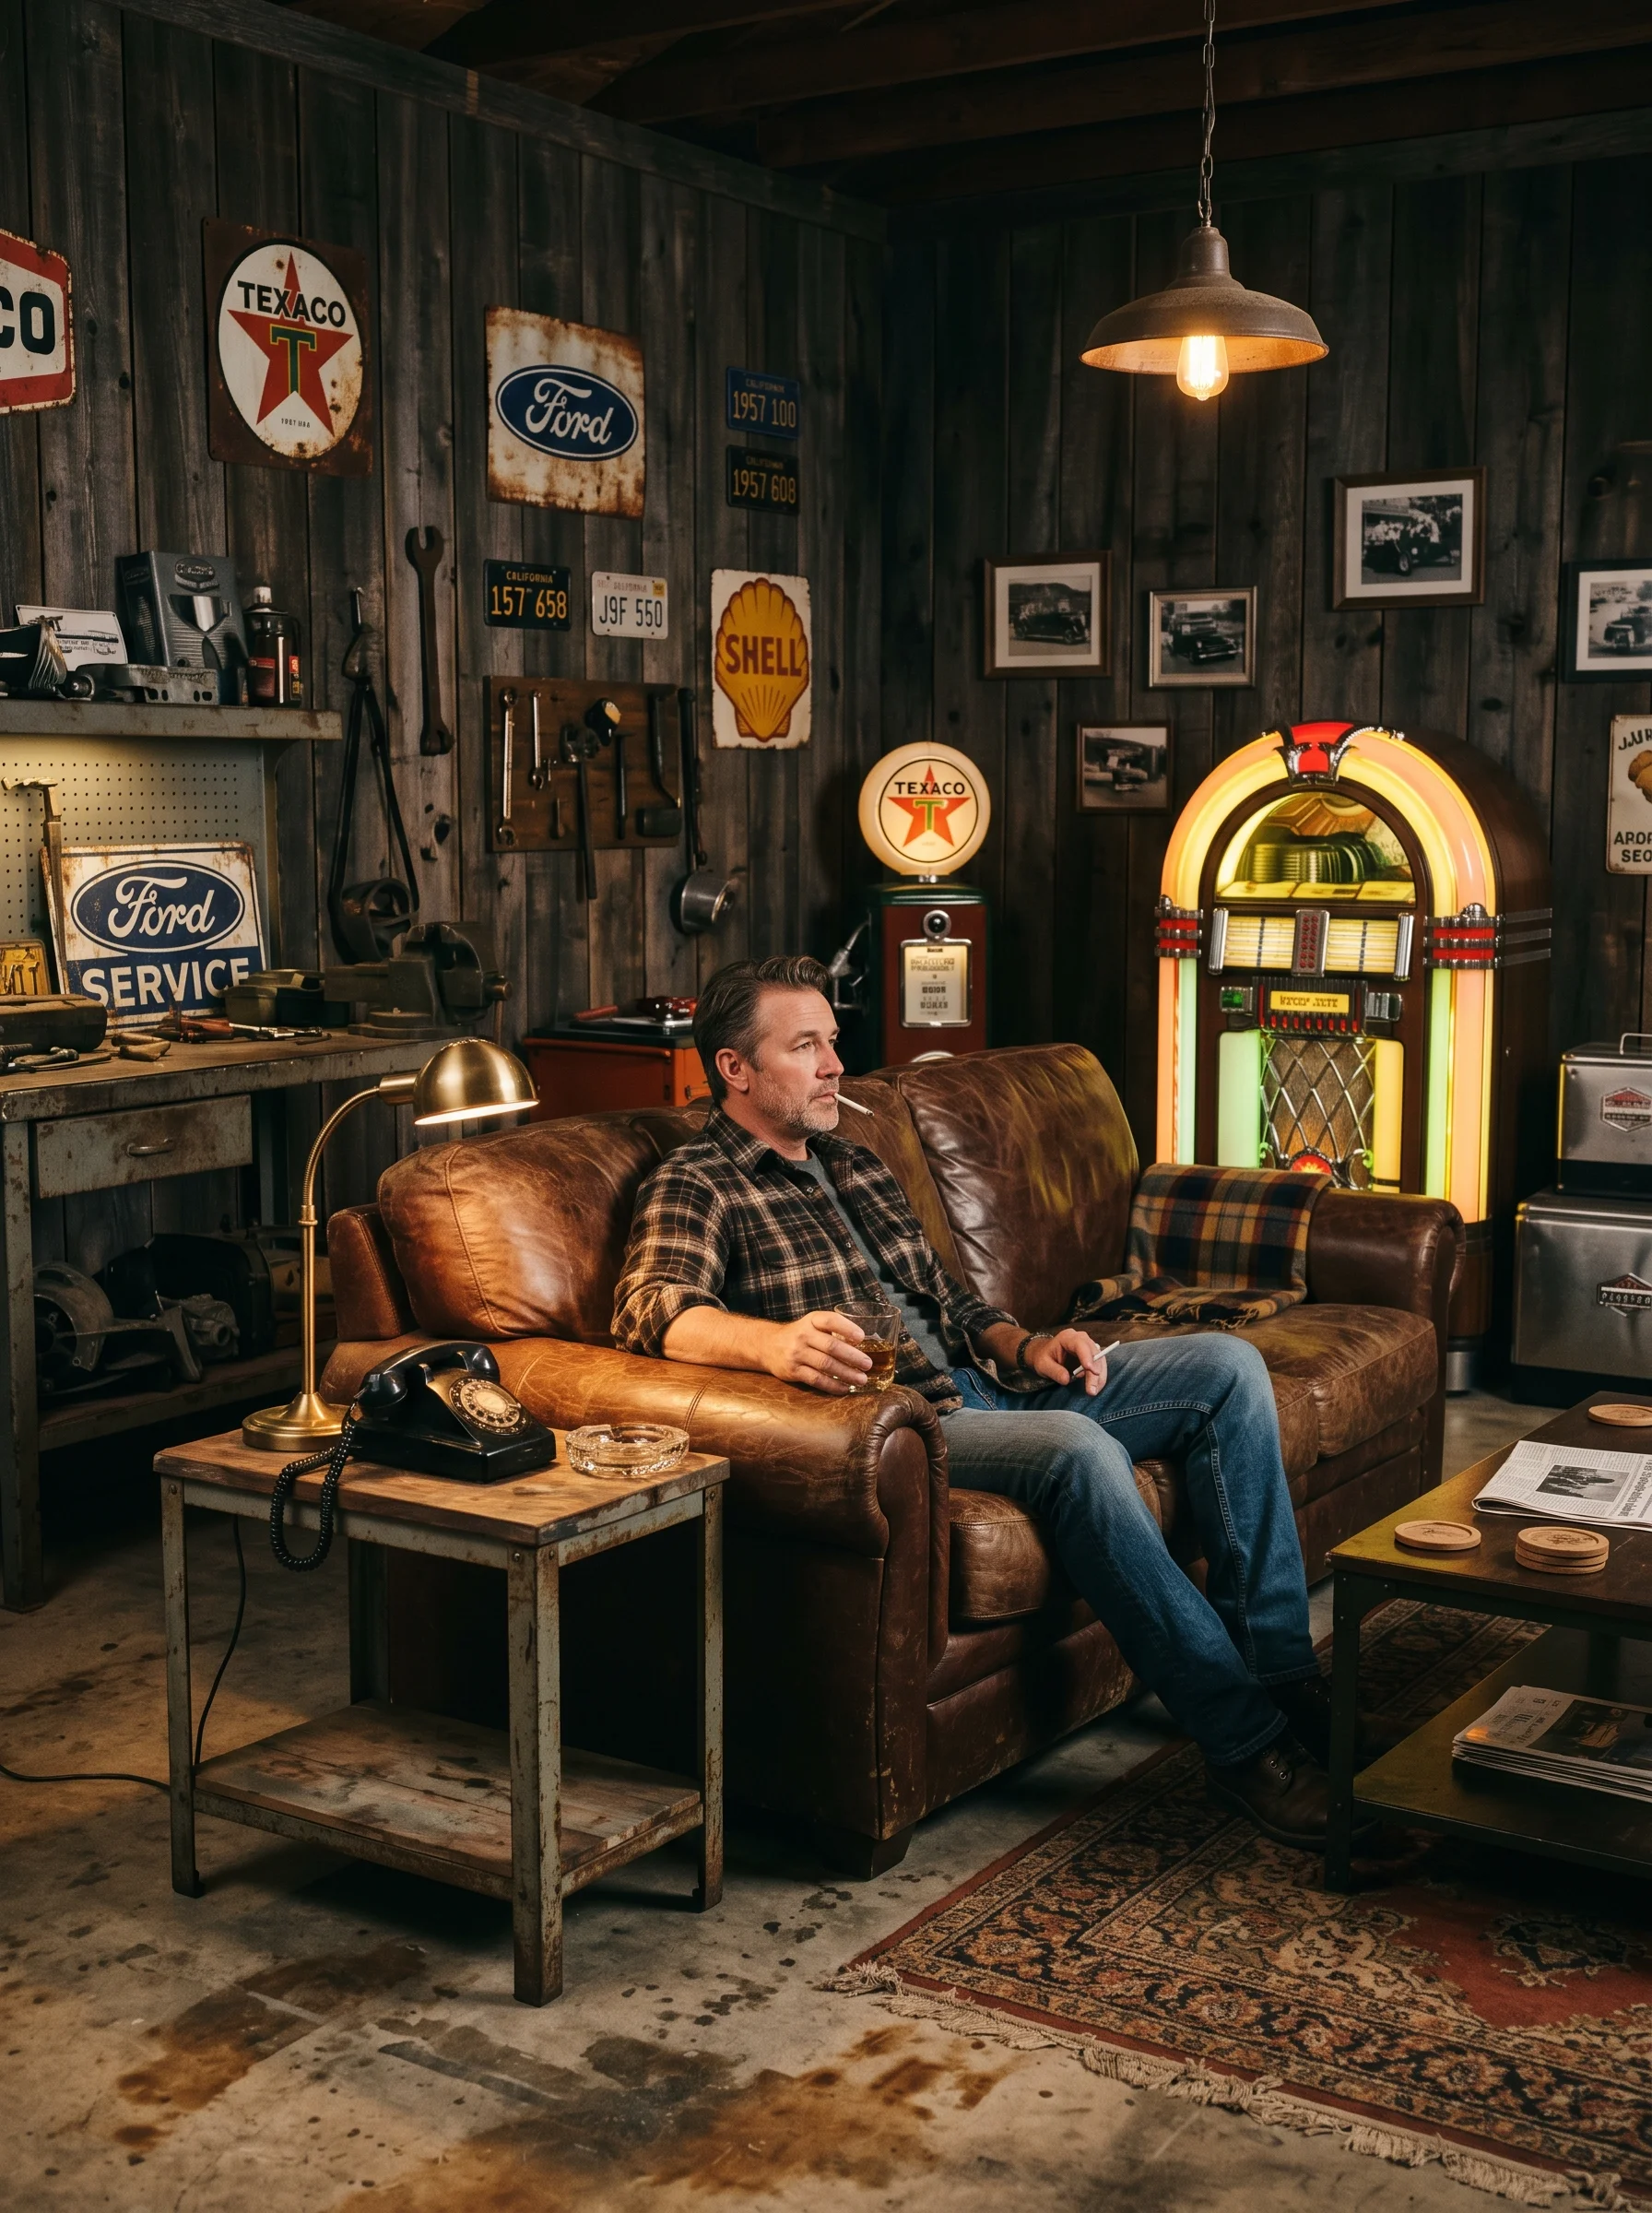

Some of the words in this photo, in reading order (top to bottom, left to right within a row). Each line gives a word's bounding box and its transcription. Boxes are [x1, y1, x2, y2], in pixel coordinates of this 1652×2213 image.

[237, 280, 346, 327] TEXACO
[525, 377, 614, 445] Ford
[733, 390, 766, 422] 1957
[772, 398, 796, 428] 100
[733, 468, 767, 499] 1957
[771, 475, 796, 503] 608
[506, 571, 553, 584] CALIFORNIA
[491, 586, 525, 617] 157
[536, 589, 567, 620] 658
[599, 595, 628, 625] J9F
[636, 598, 663, 627] 550
[726, 633, 802, 677] SHELL
[894, 781, 965, 795] TEXACO
[108, 875, 216, 938] Ford
